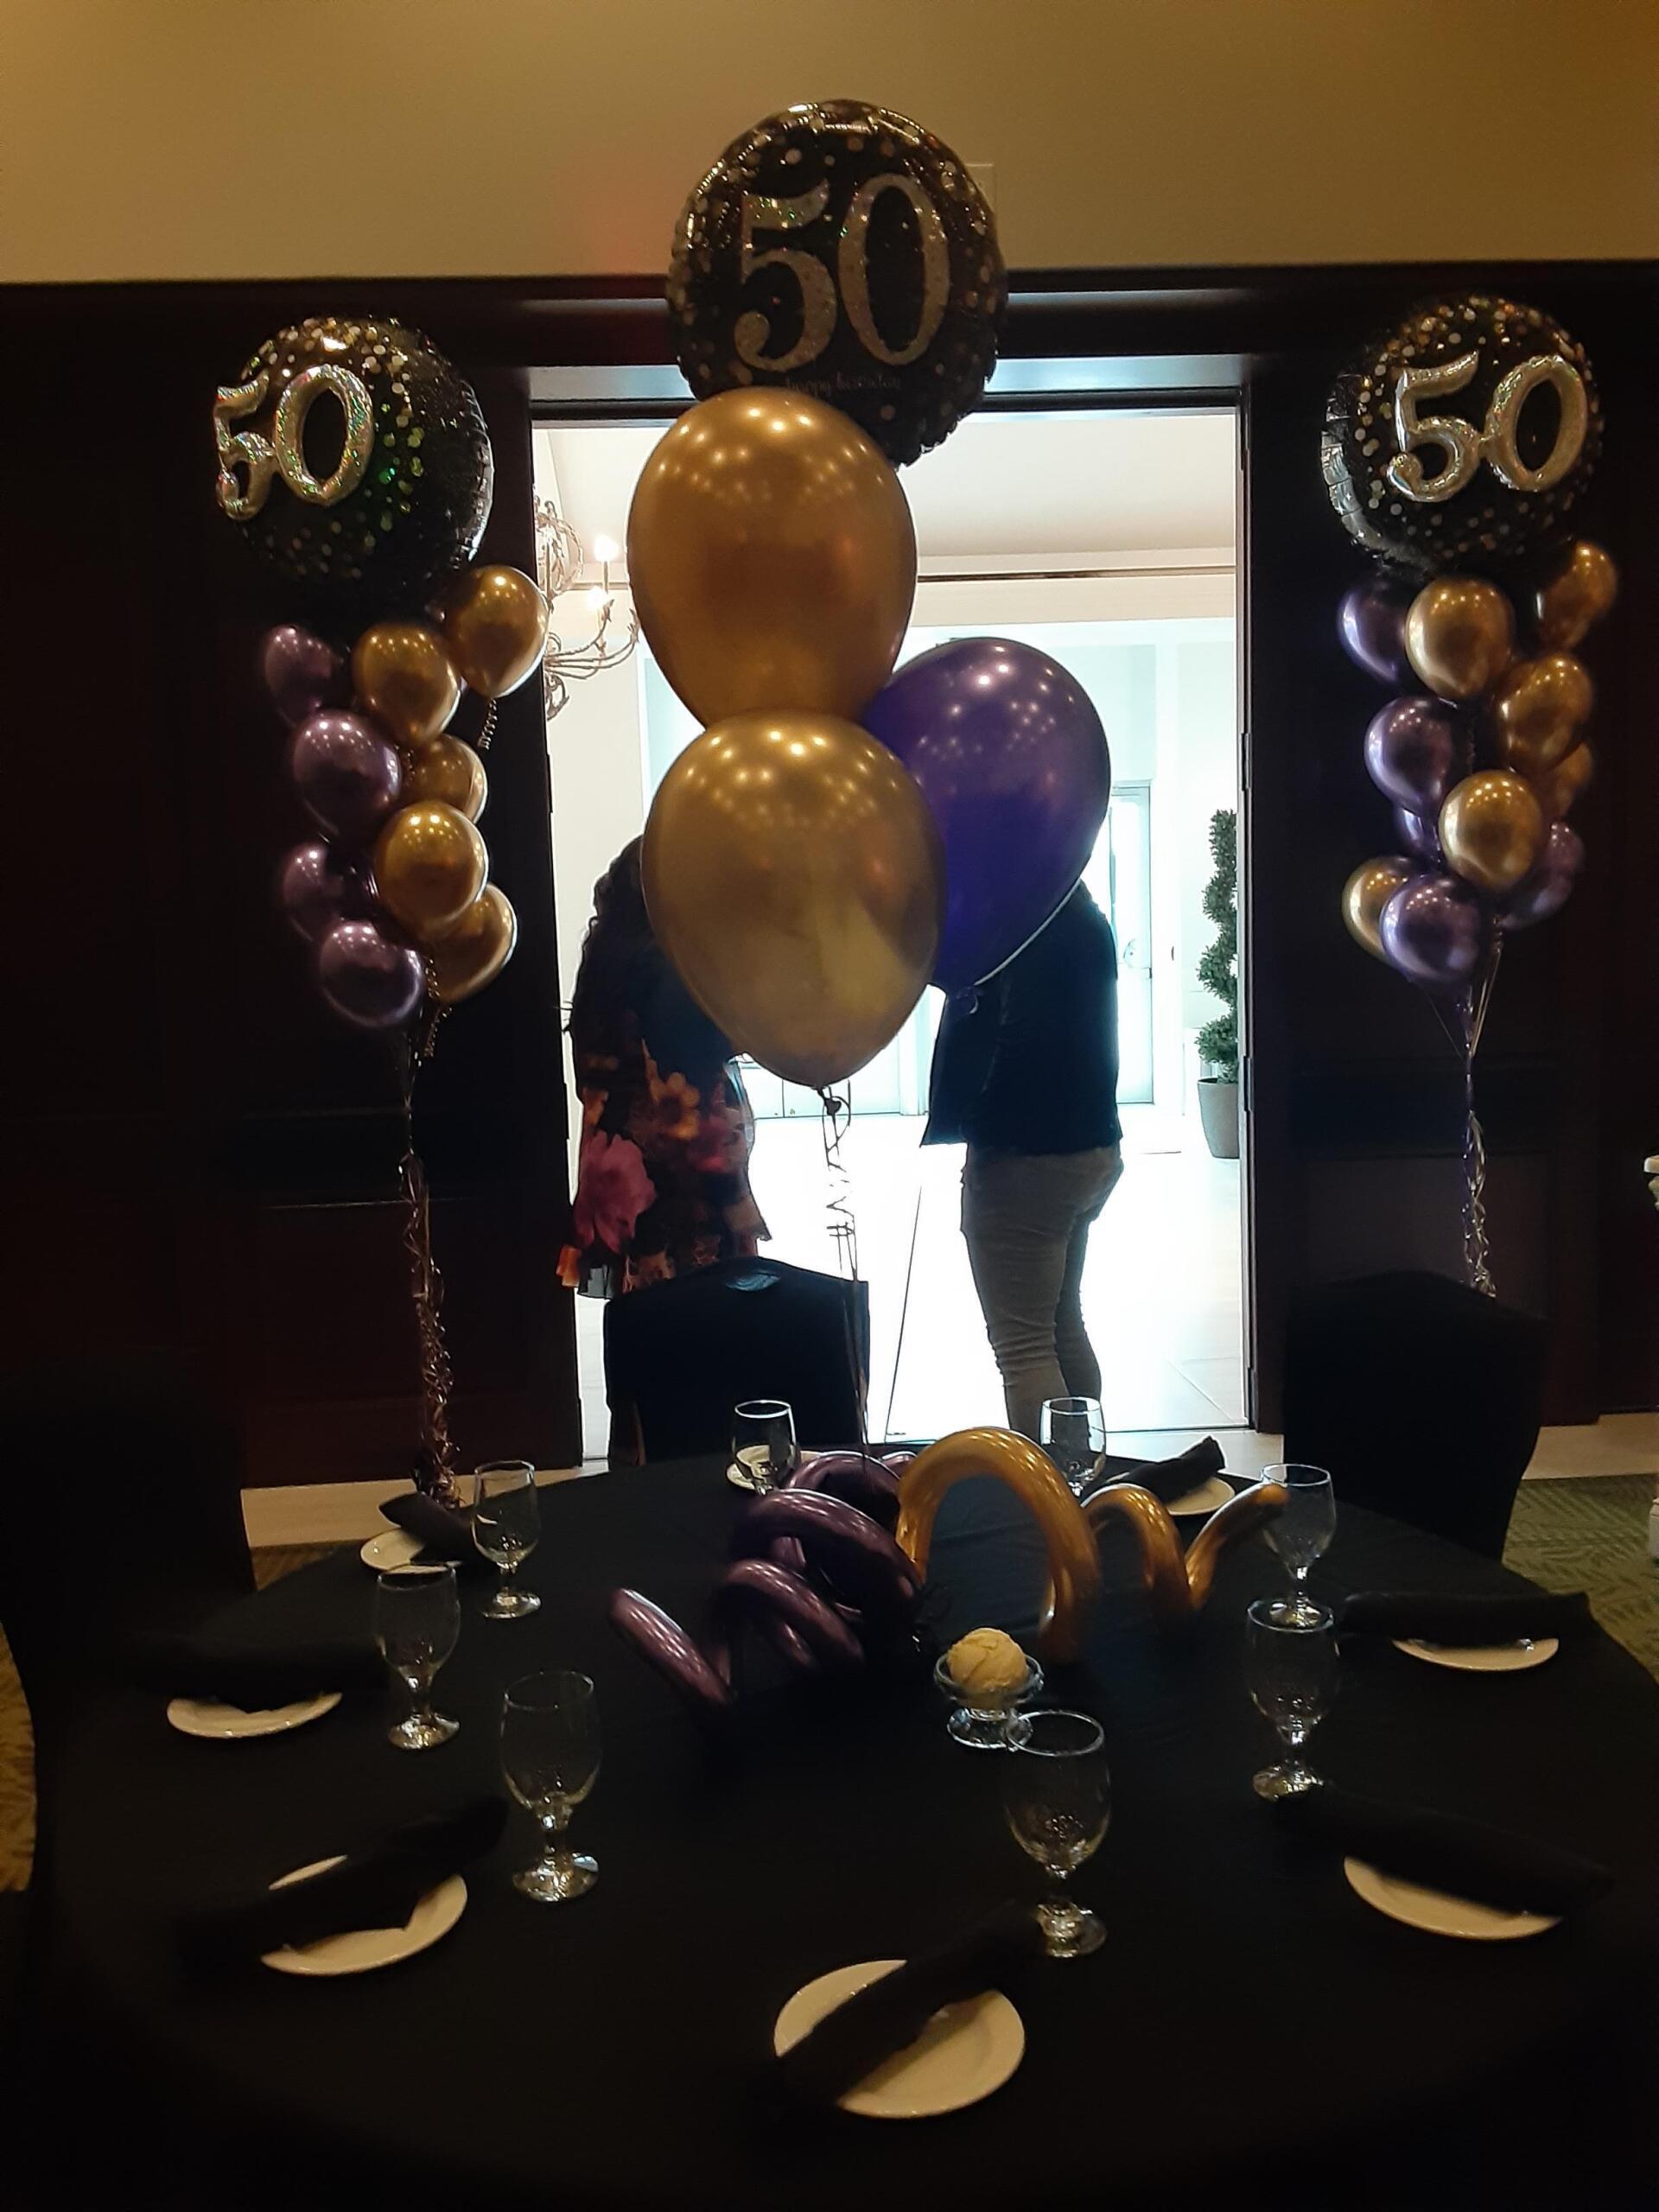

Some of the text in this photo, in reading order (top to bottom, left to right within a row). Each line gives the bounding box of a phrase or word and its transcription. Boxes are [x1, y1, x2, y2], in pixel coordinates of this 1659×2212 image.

[734, 174, 950, 373] 50
[213, 362, 375, 521] 50
[1387, 349, 1588, 503] 50
